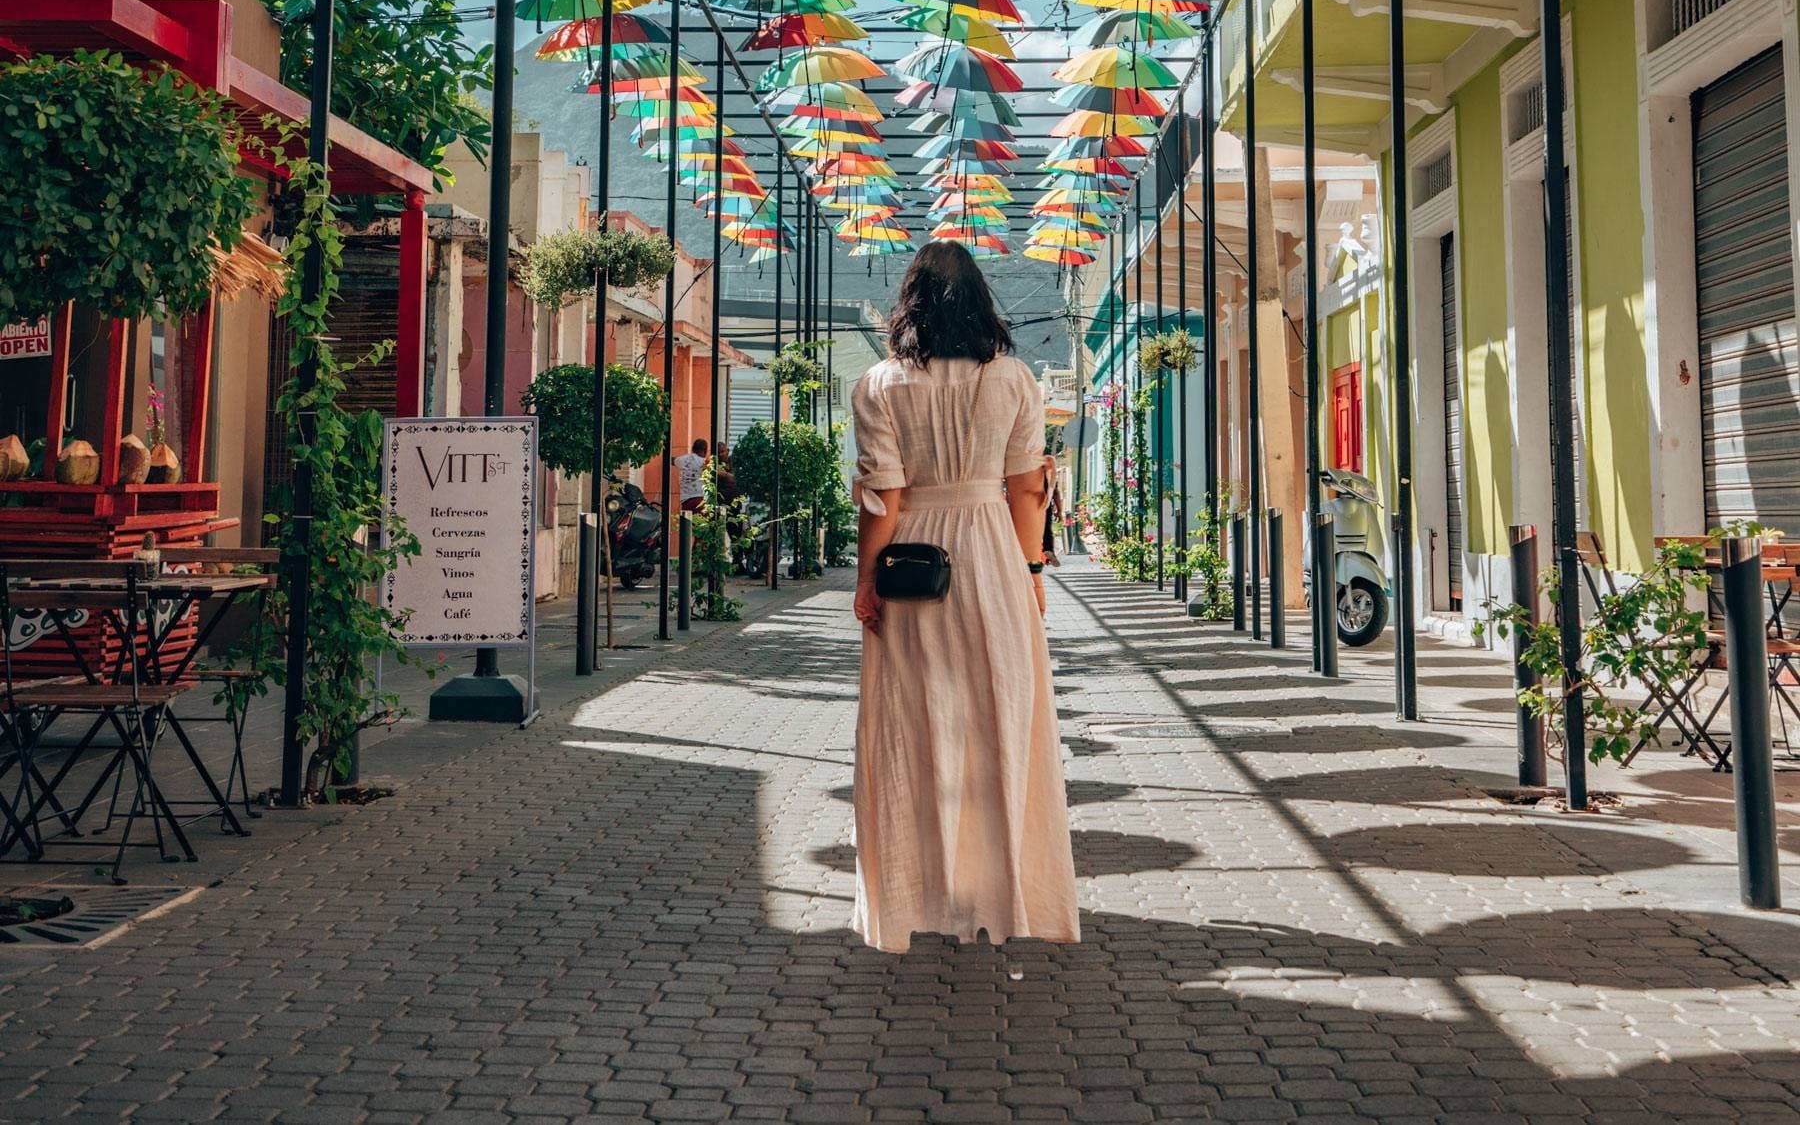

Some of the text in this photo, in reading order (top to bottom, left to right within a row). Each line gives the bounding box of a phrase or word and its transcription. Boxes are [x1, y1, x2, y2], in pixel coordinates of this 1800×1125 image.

[0, 337, 48, 355] OPEN
[431, 507, 488, 517] Refrescos
[432, 527, 486, 538] Cervezas
[435, 547, 481, 560] Sangría
[442, 567, 475, 578] Vinos
[441, 588, 473, 601] Agua
[444, 608, 471, 619] Café
